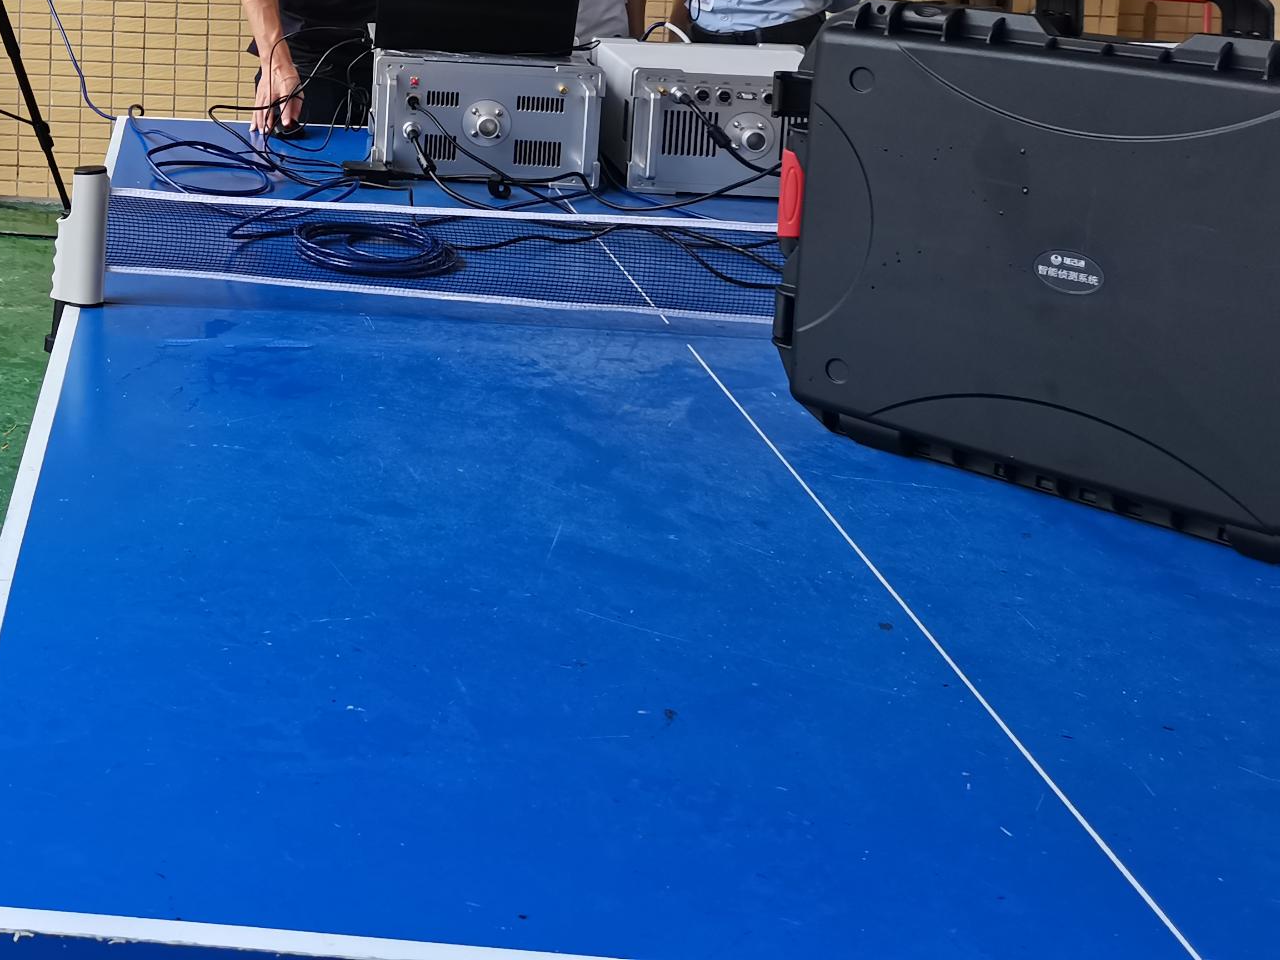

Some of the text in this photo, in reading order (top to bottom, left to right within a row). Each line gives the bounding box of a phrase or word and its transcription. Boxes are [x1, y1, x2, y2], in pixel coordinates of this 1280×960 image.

[1038, 265, 1099, 286] 智能侦测系统
